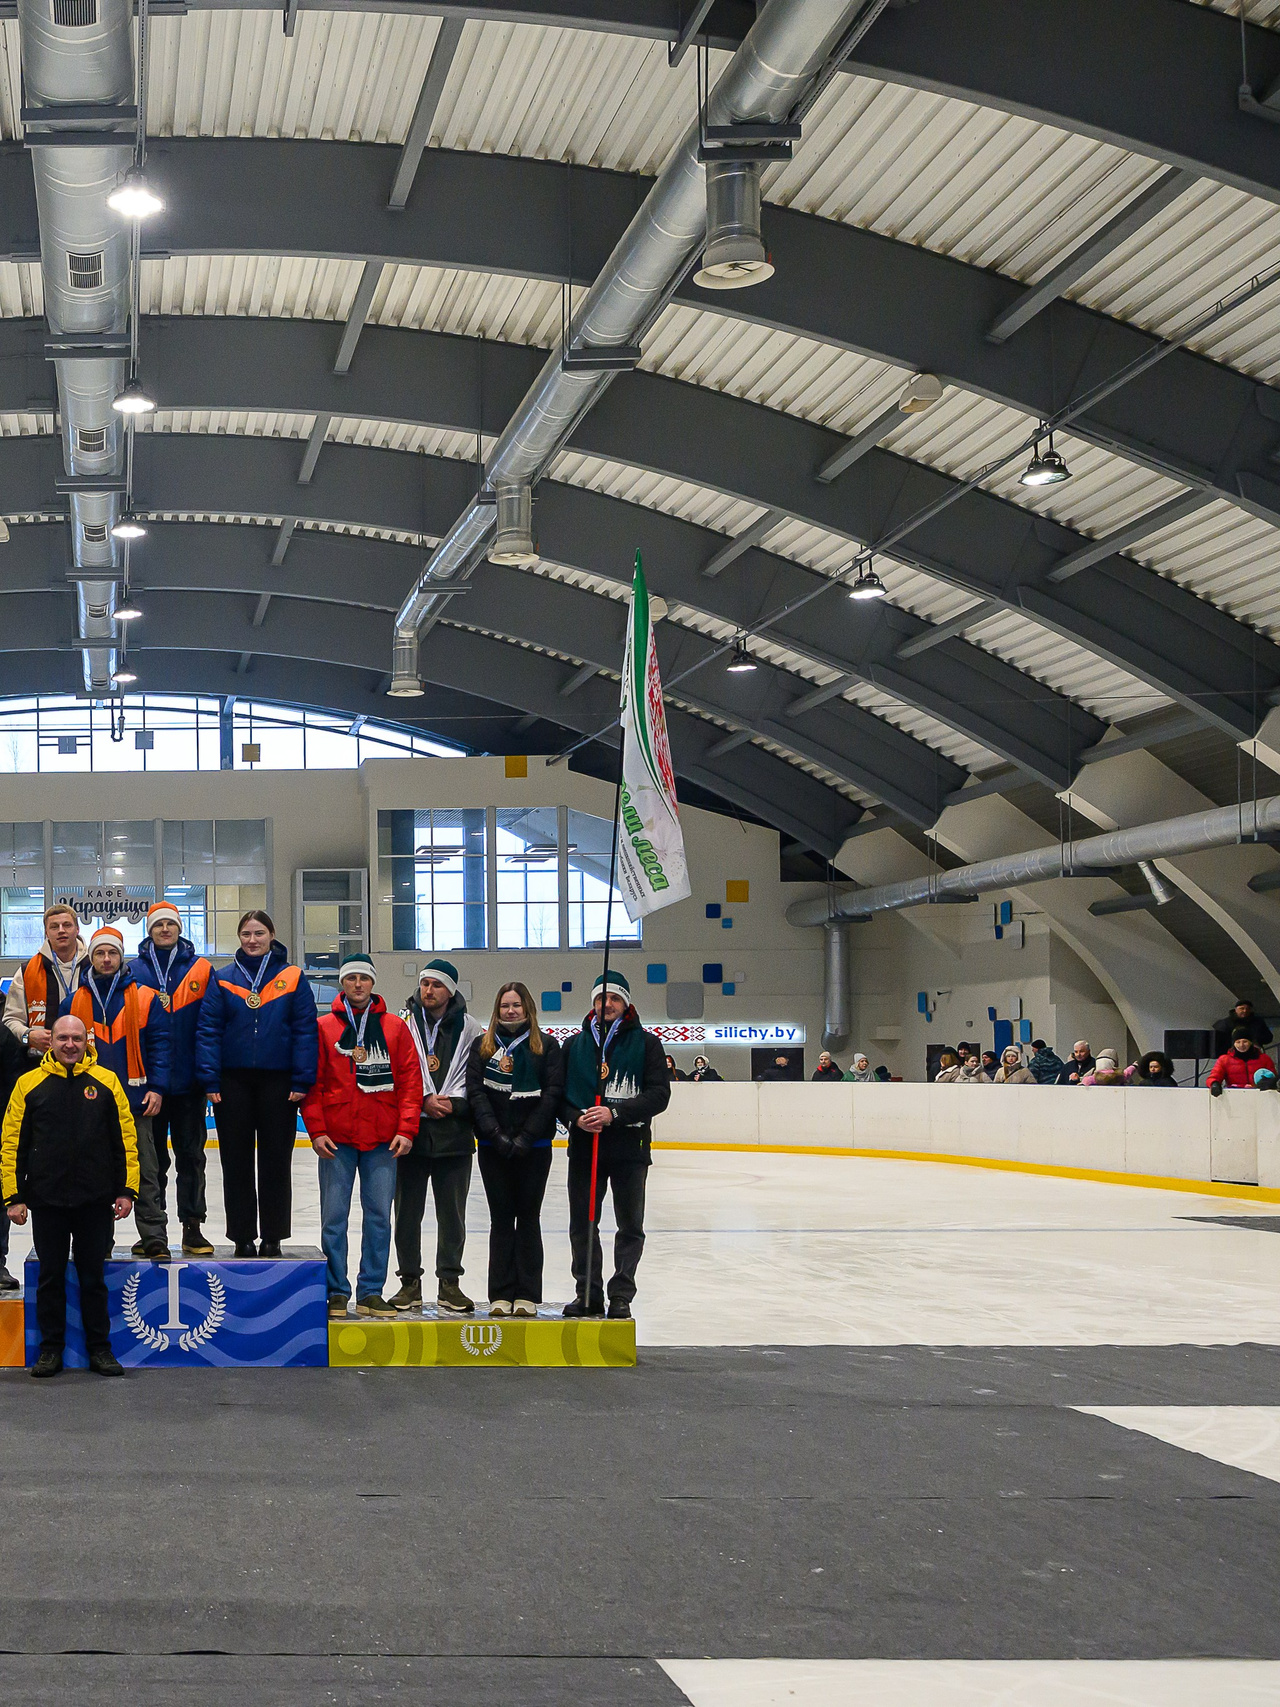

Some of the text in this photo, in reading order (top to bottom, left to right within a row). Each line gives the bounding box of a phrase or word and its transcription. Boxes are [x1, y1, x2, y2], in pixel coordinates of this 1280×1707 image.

[631, 836, 670, 893] леса
[87, 890, 122, 898] КАФЕ
[714, 1026, 797, 1040] silichy.by
[467, 1325, 495, 1344] III
